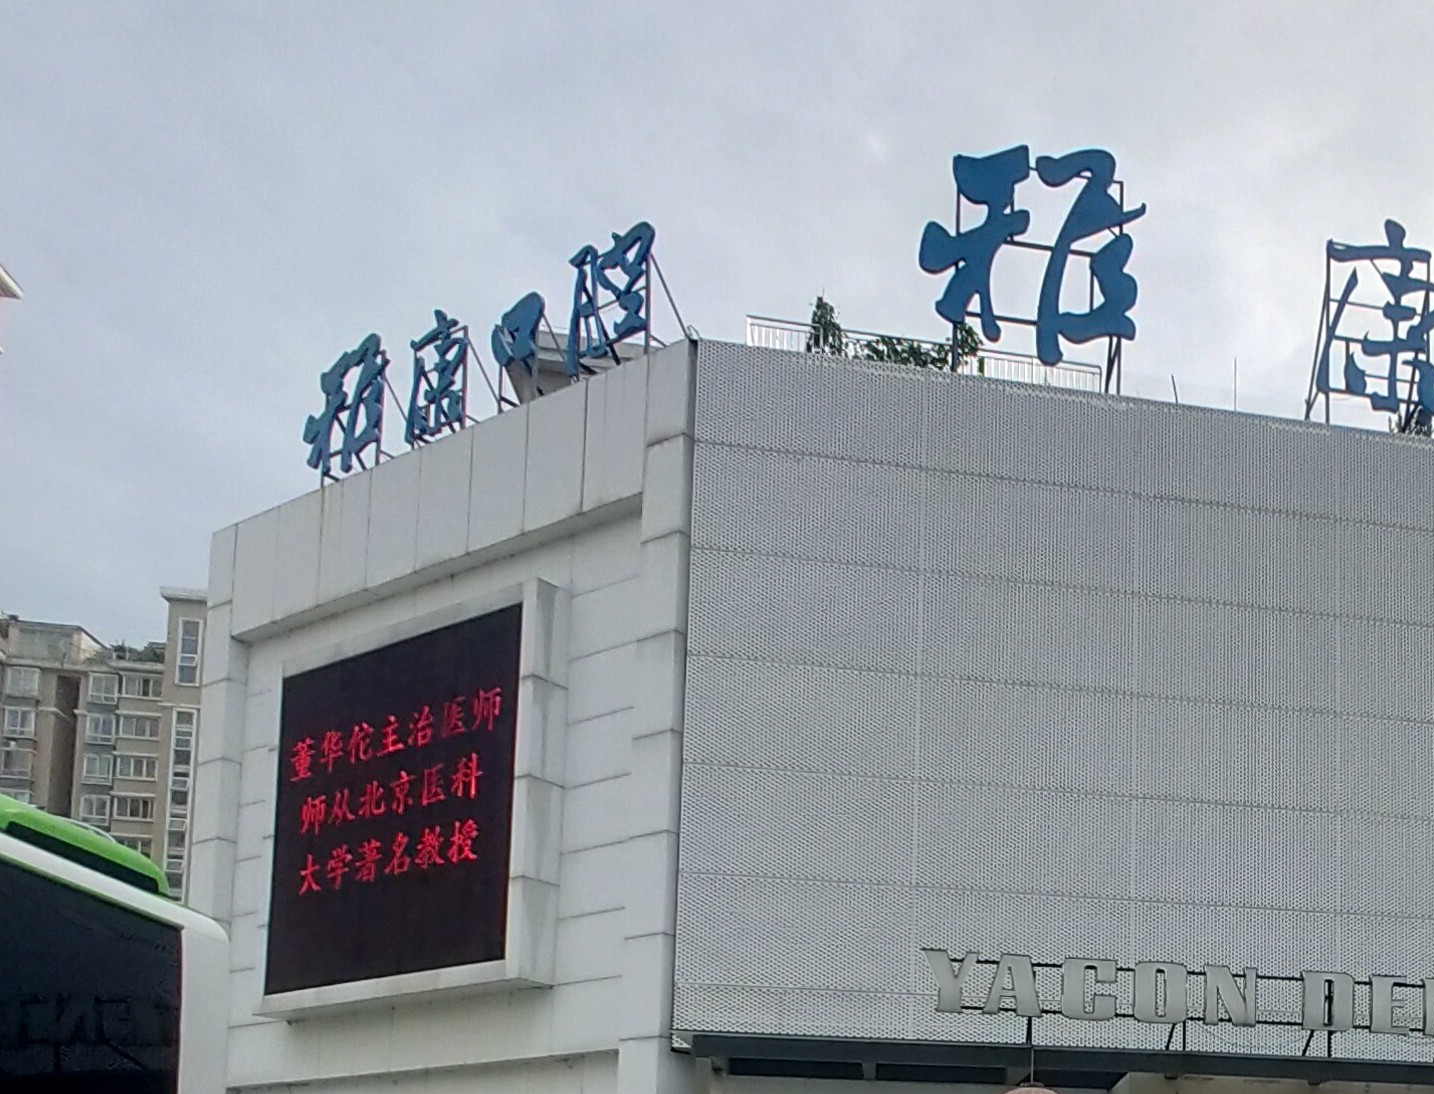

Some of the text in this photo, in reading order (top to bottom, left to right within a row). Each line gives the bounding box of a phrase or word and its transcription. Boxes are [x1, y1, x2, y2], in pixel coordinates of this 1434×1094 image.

[299, 752, 484, 836] 师从北京医科
[298, 818, 481, 896] 大学著名教授
[921, 949, 1257, 1028] YACON
